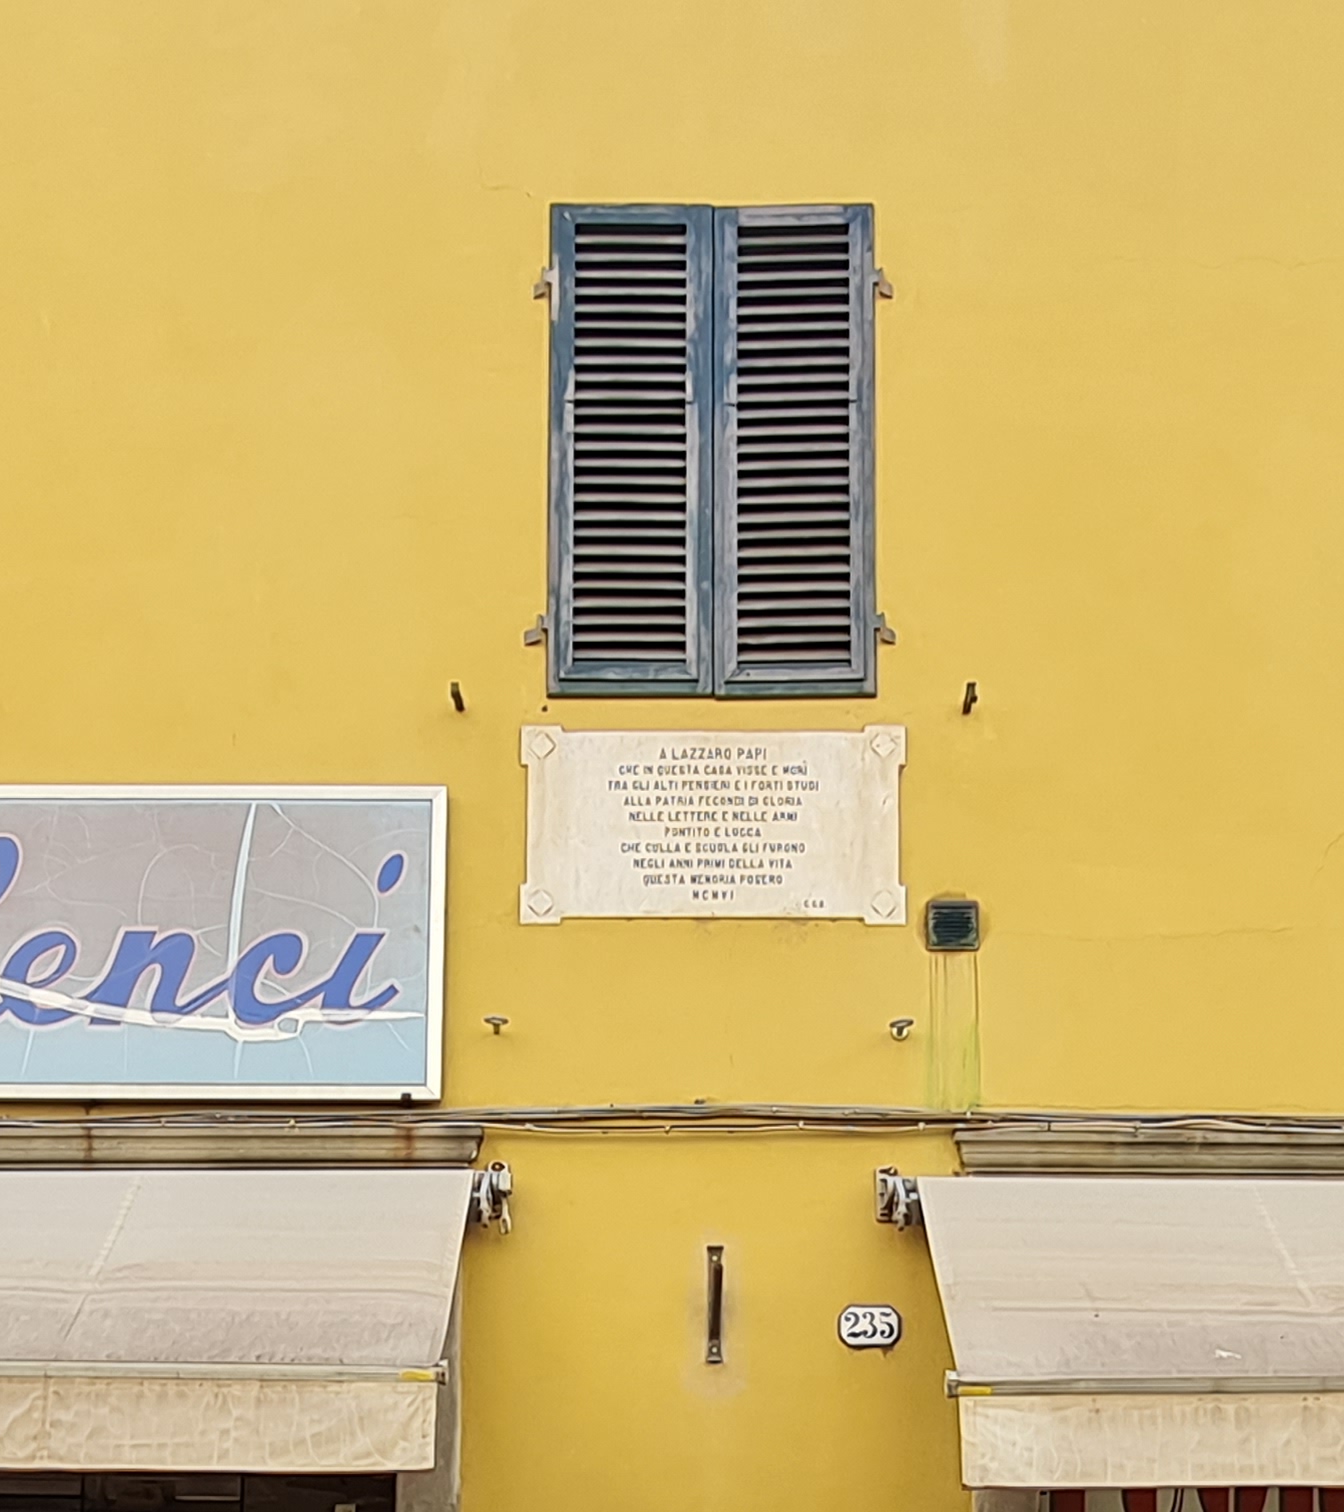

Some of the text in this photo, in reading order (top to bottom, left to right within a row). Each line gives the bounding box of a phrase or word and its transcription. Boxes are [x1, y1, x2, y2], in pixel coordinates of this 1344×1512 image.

[671, 747, 731, 760] LAZZARO
[737, 747, 766, 760] PAPI
[618, 764, 639, 776] CHE
[643, 764, 653, 776] IN
[657, 764, 699, 776] QUESTA
[704, 764, 732, 776] CASA
[736, 764, 767, 776] VISSE
[608, 780, 628, 791] TRA
[632, 780, 649, 791] GLI
[654, 780, 678, 791] ALTI
[751, 780, 783, 791] FORTI
[787, 780, 819, 791] STUDI
[624, 796, 652, 806] ALLA
[656, 796, 694, 806] PATRIA
[762, 796, 803, 806] GLORIA
[629, 811, 665, 821] NELLE
[668, 811, 717, 821] LETTERE
[732, 811, 767, 821] NELLE
[725, 827, 761, 837] LUCCA
[621, 843, 641, 853] CHE
[696, 843, 738, 853] SCUOLA
[742, 843, 759, 853] GLI
[763, 843, 806, 853] FURONO
[633, 859, 792, 869] NEGLI ANNI PRIMI DELLA VITA
[643, 874, 685, 887] QUESTA
[690, 874, 736, 885] MEMORIA
[844, 1311, 895, 1339] 235
